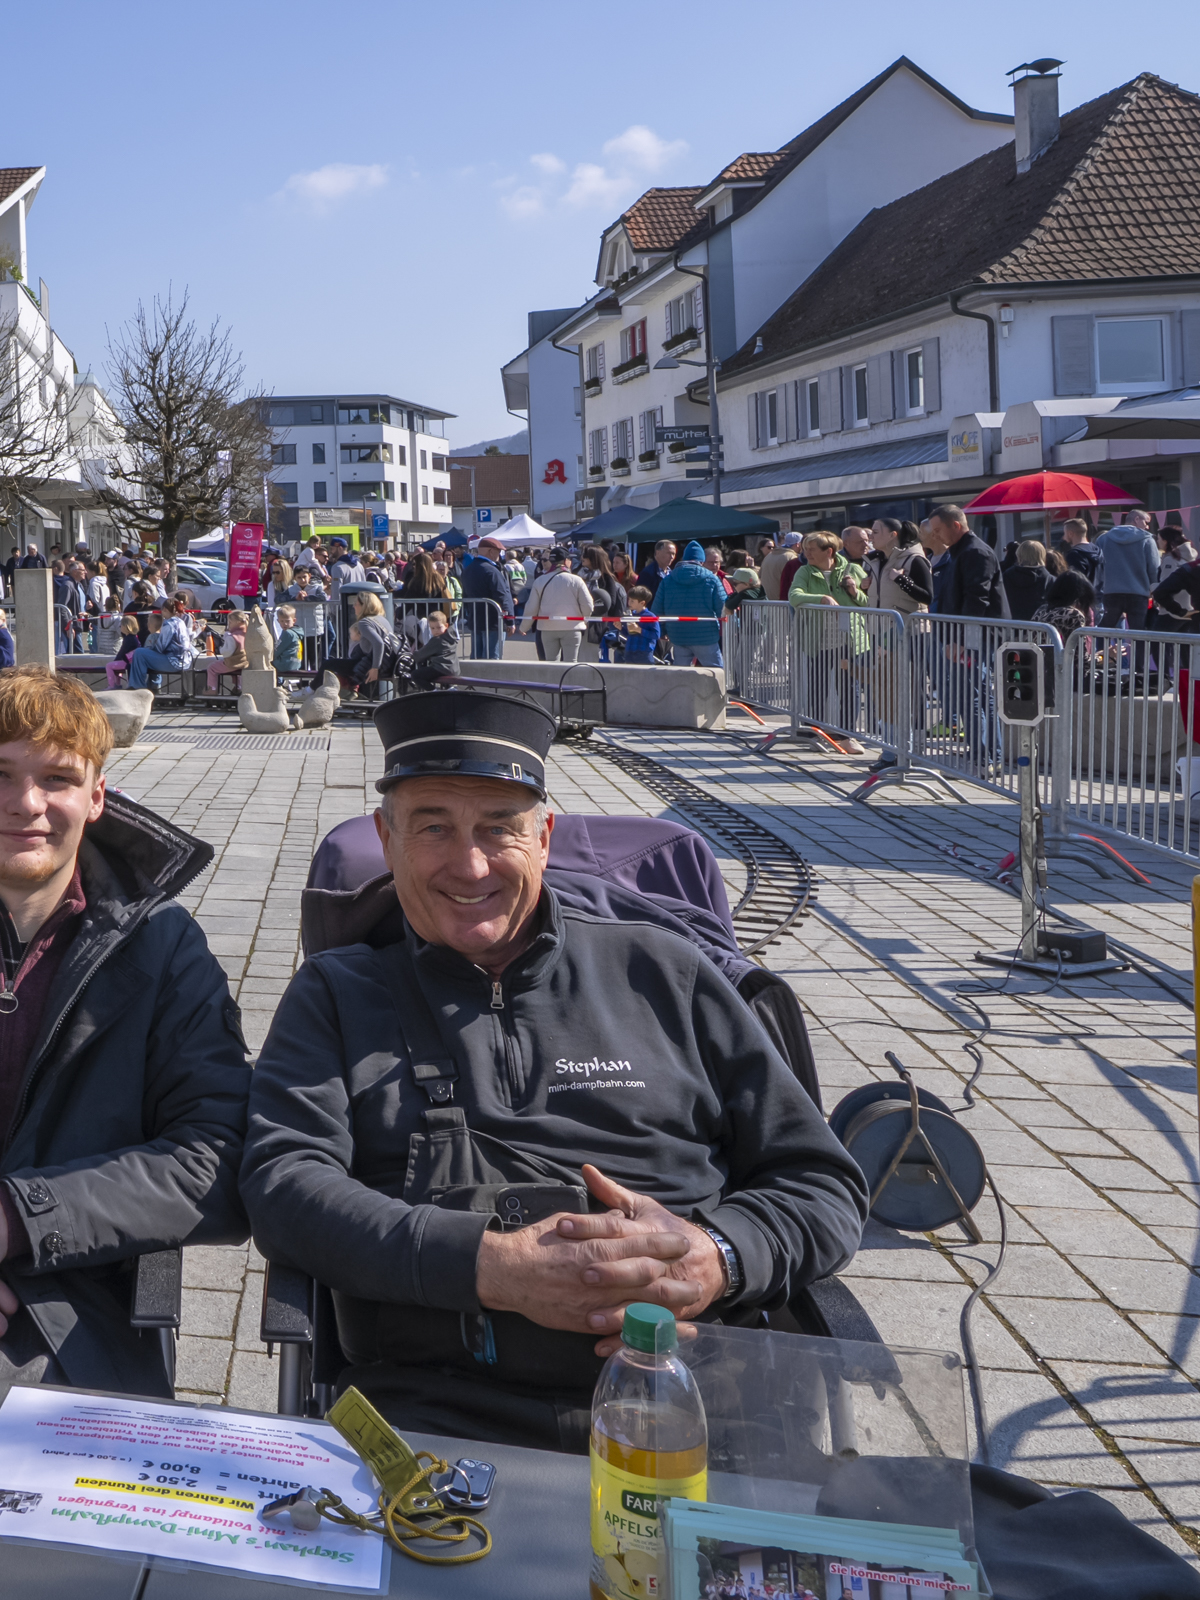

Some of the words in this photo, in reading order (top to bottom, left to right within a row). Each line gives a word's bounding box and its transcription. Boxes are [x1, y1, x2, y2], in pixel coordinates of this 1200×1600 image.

[664, 430, 708, 439] mutter
[480, 510, 488, 521] P
[555, 1056, 632, 1078] Stephan
[548, 1079, 646, 1094] mini-dampfbahn.com
[36, 1420, 76, 1430] lassen!
[60, 1416, 137, 1428] hinauslehnen!
[79, 1425, 133, 1436] Trittblech
[140, 1424, 169, 1432] nicht
[173, 1427, 217, 1439] bleiben,
[56, 1430, 137, 1444] Begleitperson!
[185, 1436, 215, 1446] Fahrt
[220, 1434, 255, 1444] sitzen
[184, 1444, 217, 1453] Jahre
[218, 1441, 238, 1449] der
[241, 1444, 292, 1457] während
[258, 1439, 309, 1451] Aufrecht
[42, 1449, 71, 1457] Fahrt)
[230, 1450, 262, 1459] unter
[295, 1452, 330, 1463] Füsse
[142, 1460, 154, 1468] €
[265, 1455, 305, 1467] Kinder
[160, 1462, 201, 1475] 8,00
[138, 1473, 151, 1482] €
[156, 1475, 198, 1488] 2,50
[75, 1479, 136, 1492] Runden!
[141, 1486, 170, 1496] drei
[176, 1491, 224, 1505] fahren
[626, 1494, 661, 1513] FAR
[58, 1496, 137, 1512] Vergnügen
[229, 1500, 254, 1510] Wir
[143, 1506, 166, 1517] ins
[169, 1509, 252, 1531] Volldampf
[604, 1510, 663, 1539] APFELSC
[51, 1508, 240, 1545] Mini-Dampfbahn
[258, 1526, 286, 1537] mit
[830, 1564, 848, 1575] Sie
[850, 1567, 896, 1582] können
[899, 1576, 921, 1586] uns
[924, 1580, 971, 1591] mieten!
